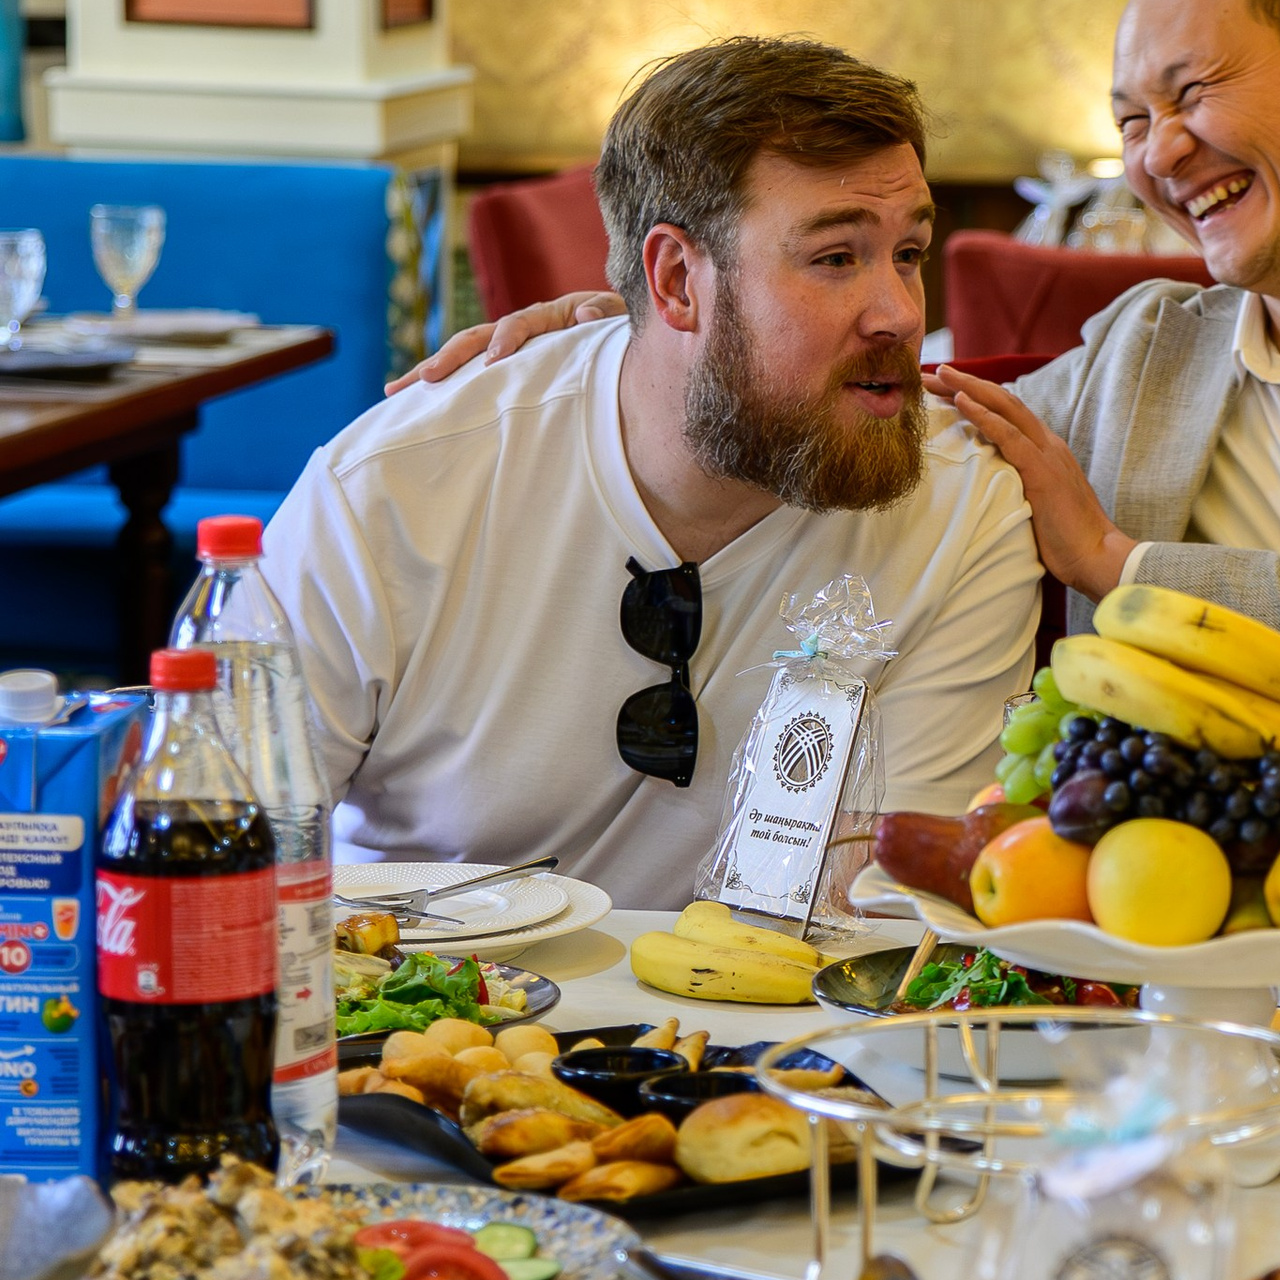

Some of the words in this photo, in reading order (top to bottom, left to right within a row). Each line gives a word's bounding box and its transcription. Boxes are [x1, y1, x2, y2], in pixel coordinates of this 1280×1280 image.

[749, 808, 763, 824] Әр
[750, 828, 771, 841] той
[772, 830, 813, 848] болсын!
[1, 946, 28, 967] 10
